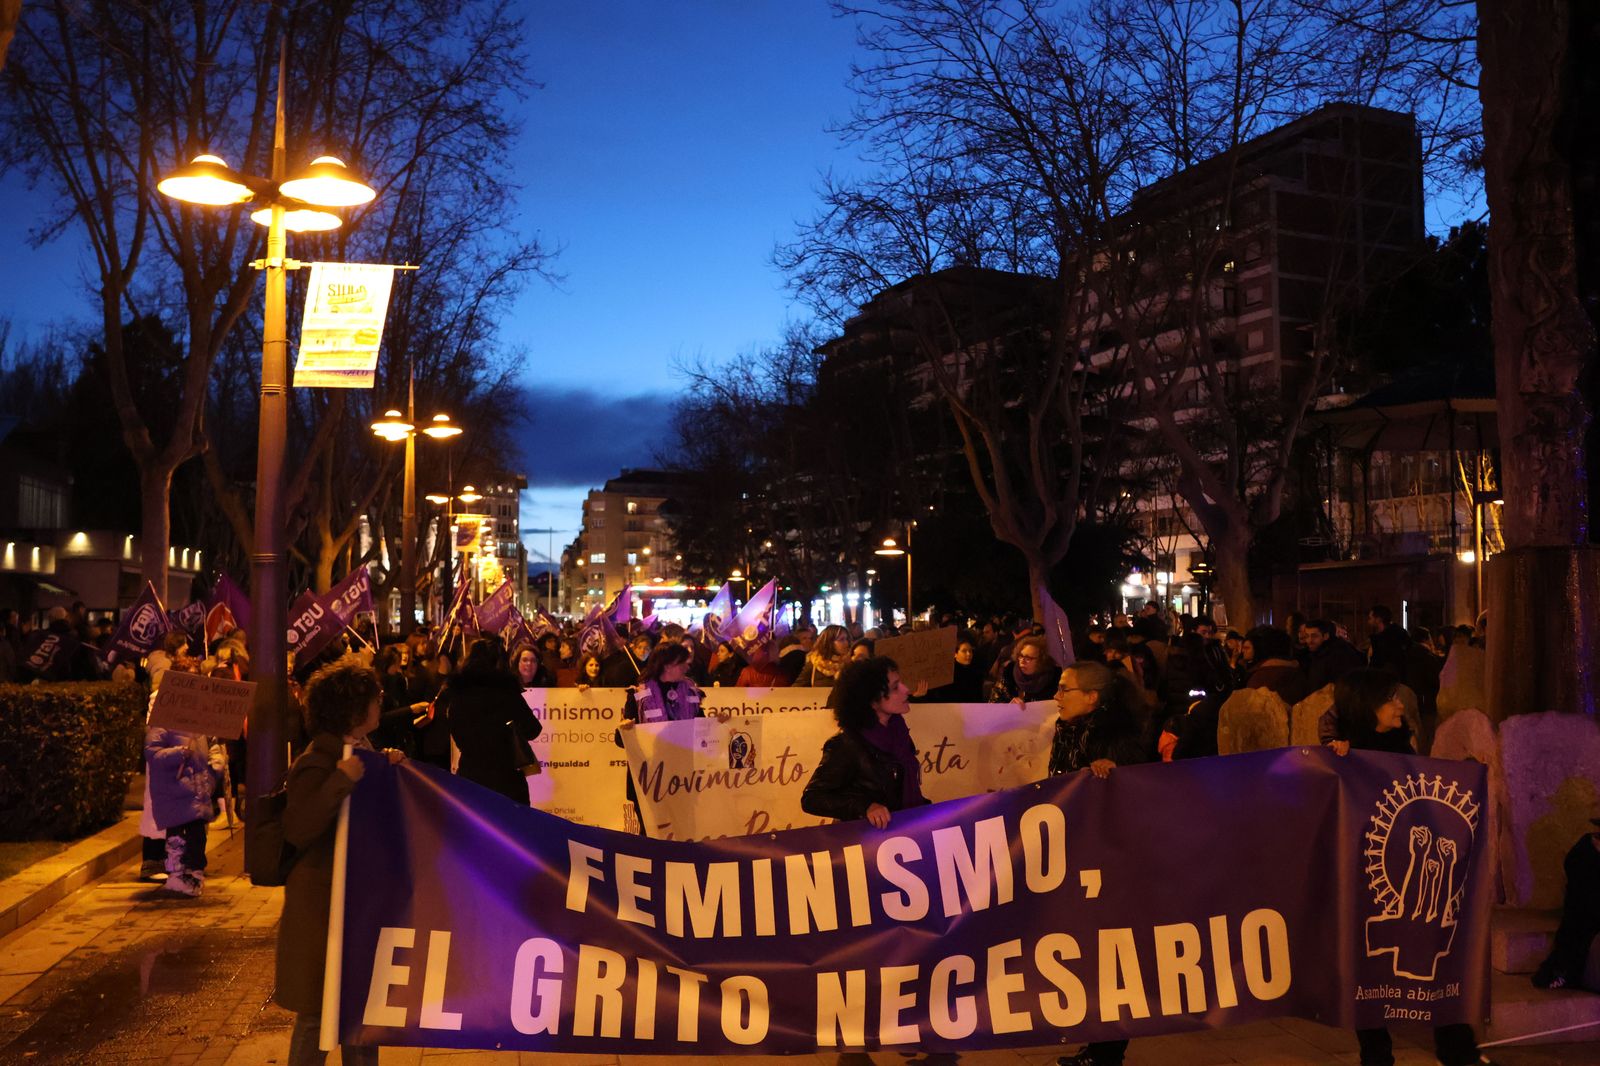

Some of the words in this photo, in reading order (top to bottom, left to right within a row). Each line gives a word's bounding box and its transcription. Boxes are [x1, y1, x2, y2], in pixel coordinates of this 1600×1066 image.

[170, 676, 198, 689] QUE
[638, 745, 808, 803] Movimiento
[565, 803, 1102, 938] FEMINISMO,
[362, 927, 463, 1031] EL
[510, 937, 770, 1045] GRITO
[816, 908, 1292, 1047] NECESARIO
[1355, 984, 1402, 1000] Asamblea
[1445, 983, 1460, 997] 8M
[1384, 1004, 1432, 1021] Zamora
